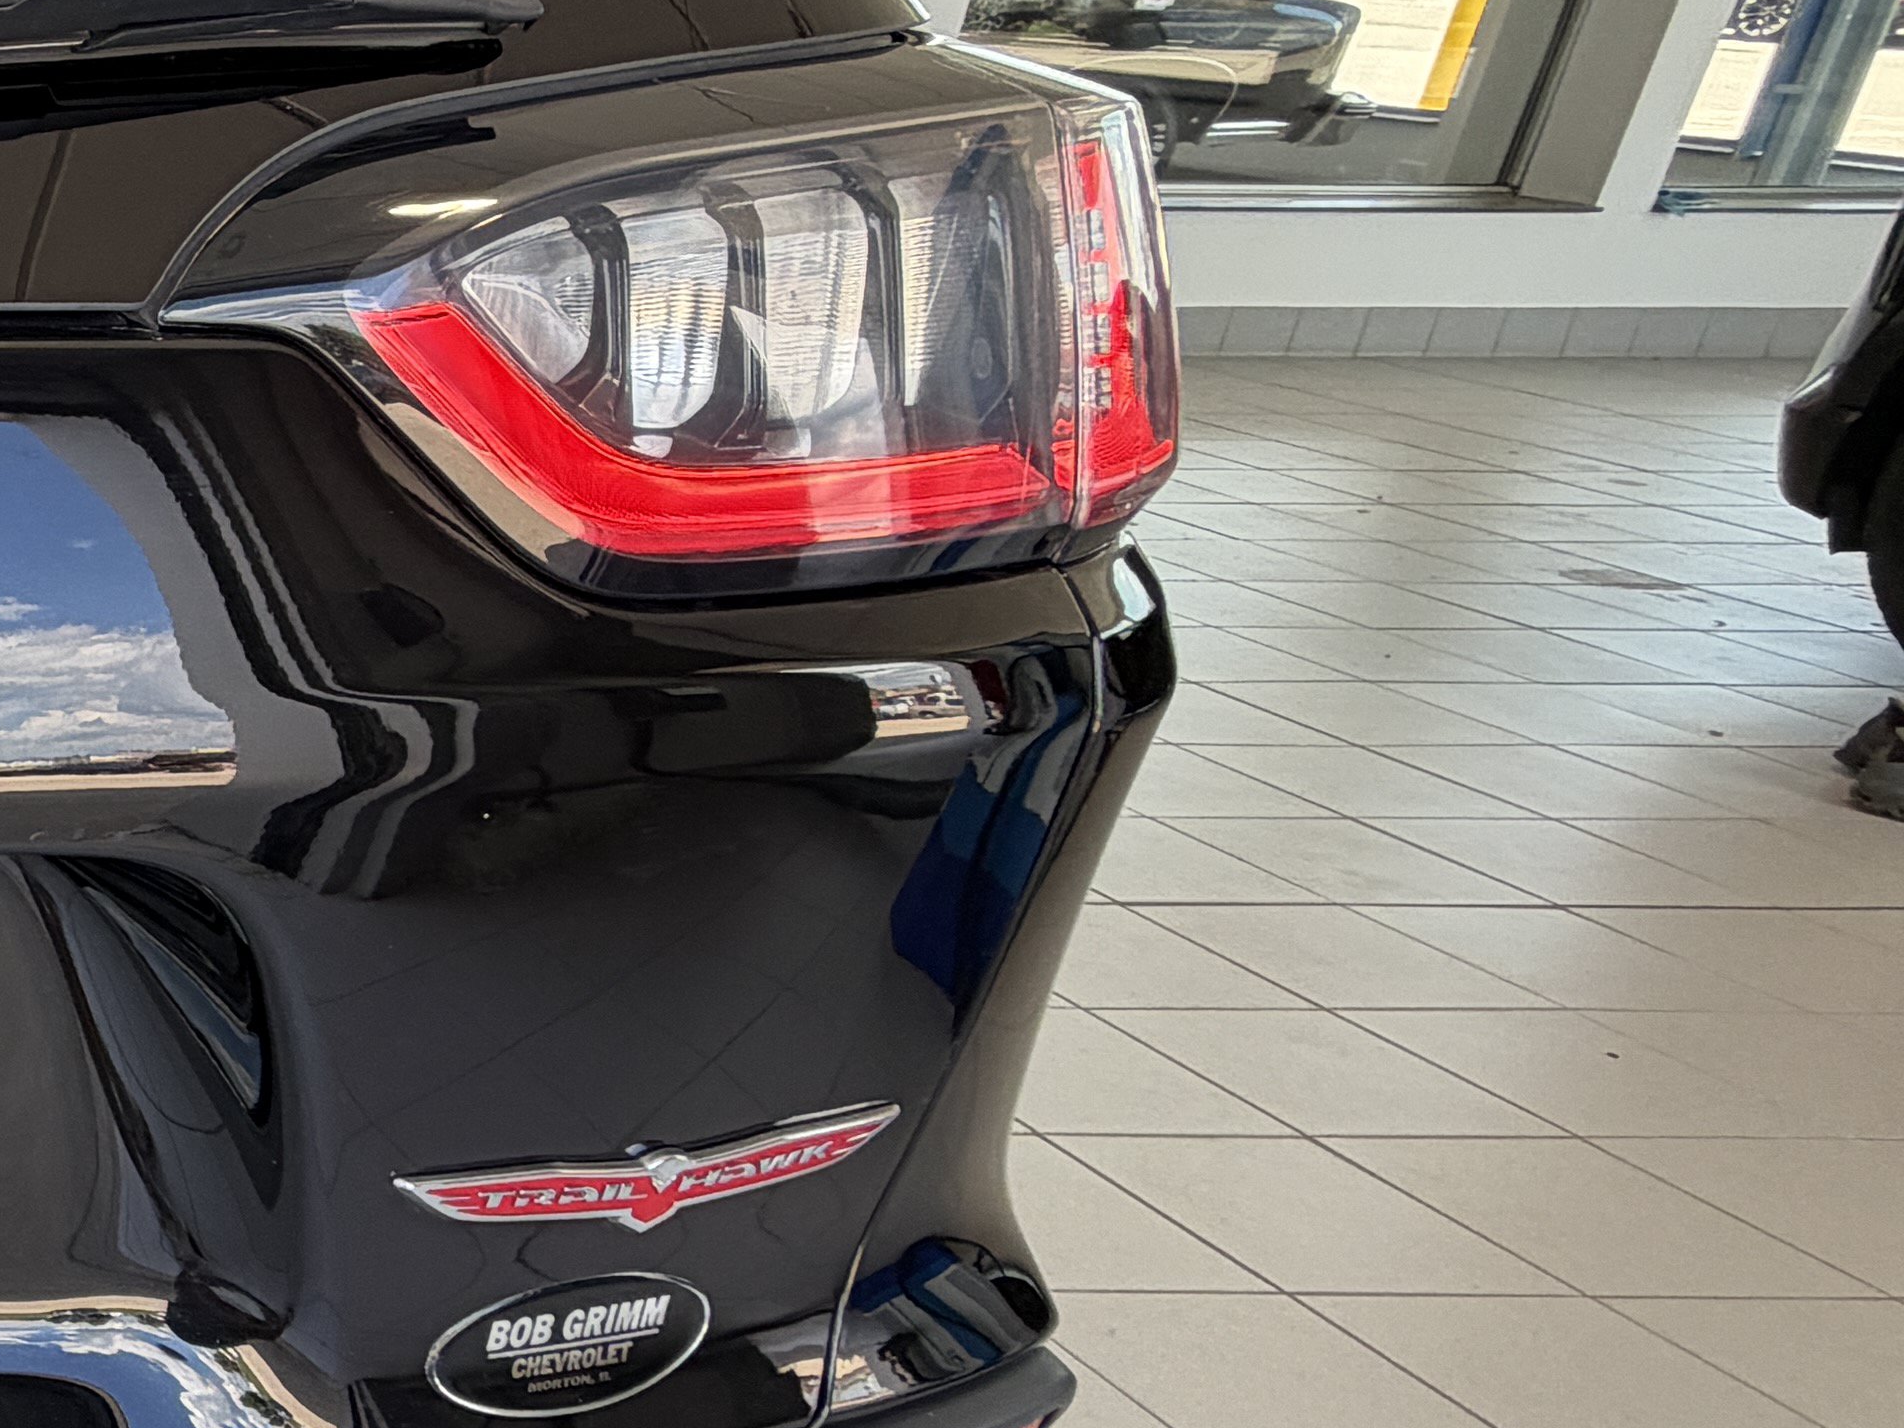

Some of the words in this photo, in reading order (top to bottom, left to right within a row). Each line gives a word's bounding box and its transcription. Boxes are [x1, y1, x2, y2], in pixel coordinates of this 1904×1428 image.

[485, 1313, 556, 1352] BOB
[562, 1294, 671, 1341] GRIMM
[511, 1340, 634, 1380] CHEVROLET
[527, 1375, 596, 1394] MORTON,
